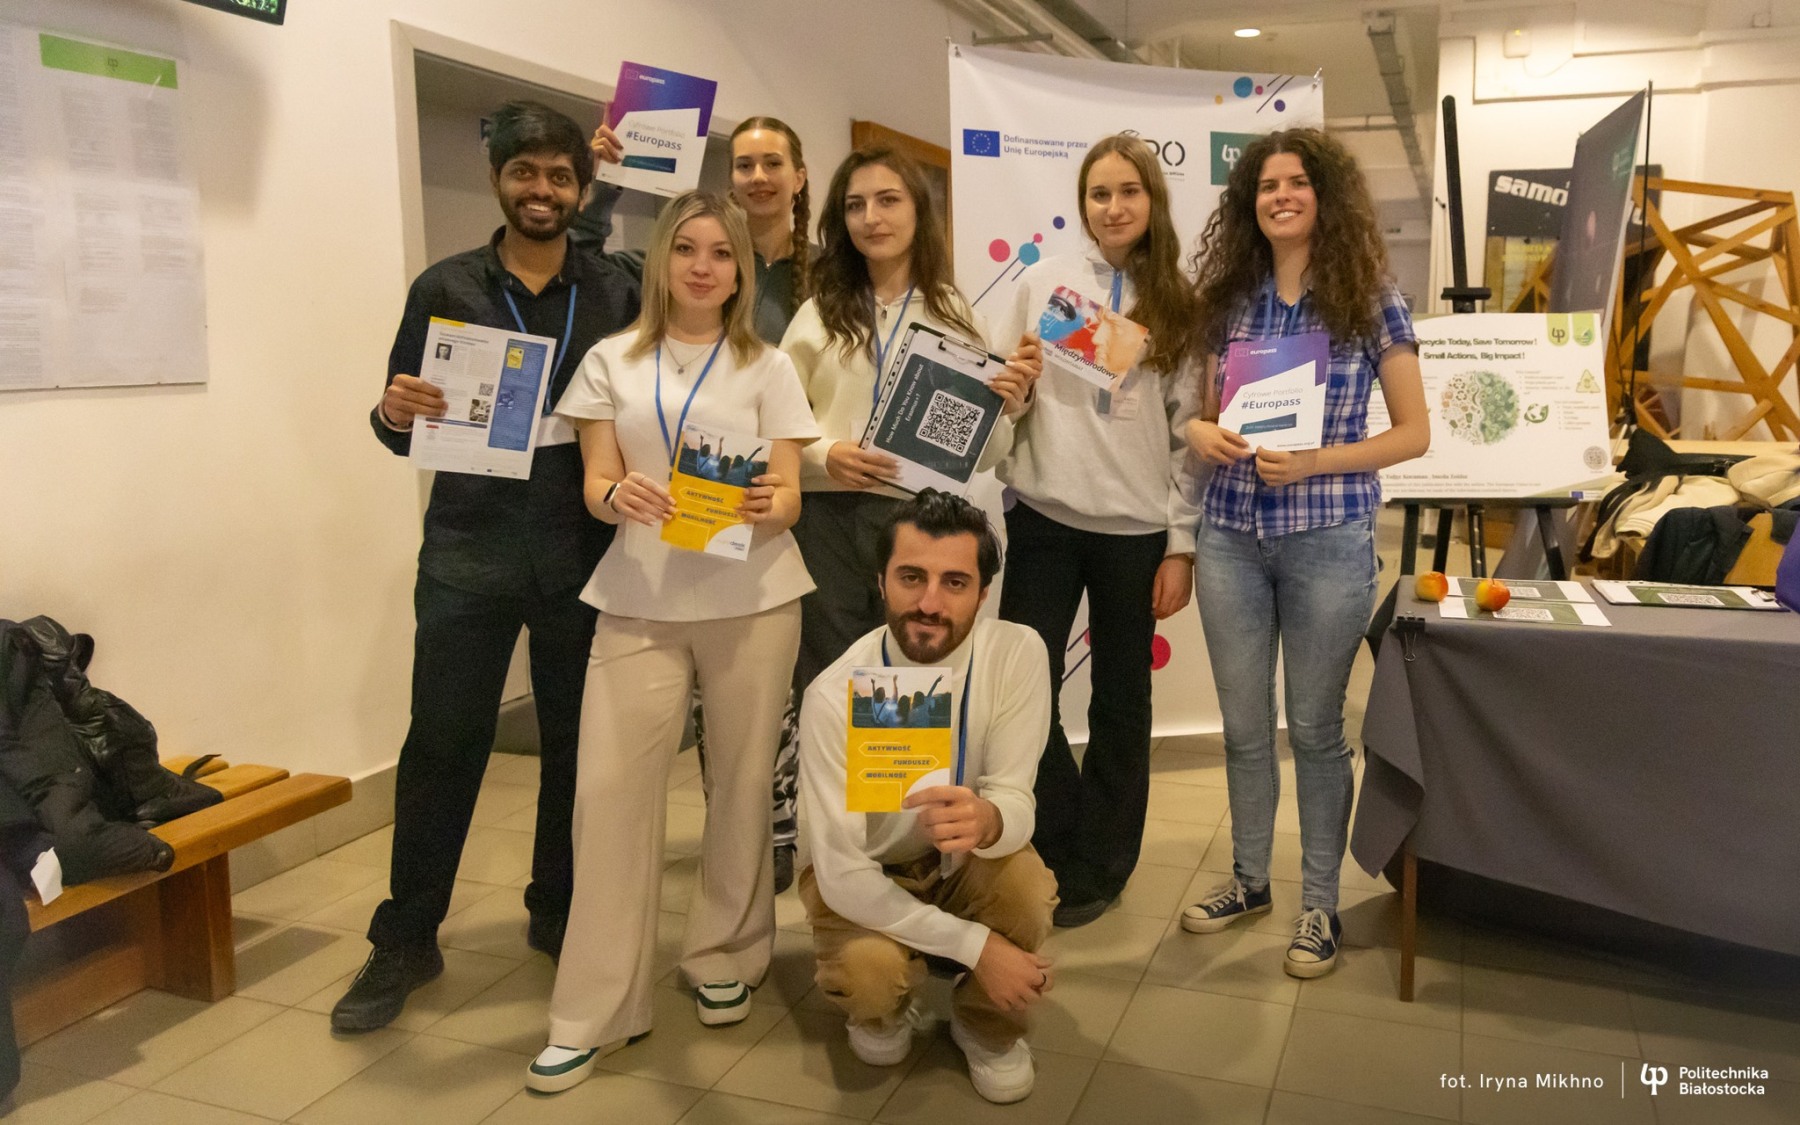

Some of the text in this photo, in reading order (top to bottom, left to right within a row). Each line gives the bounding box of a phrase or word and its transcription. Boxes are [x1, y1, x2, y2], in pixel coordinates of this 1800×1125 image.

[626, 130, 682, 151] #Europass
[1003, 134, 1088, 149] Dofinansowane przez
[1003, 145, 1069, 159] Unię Europejską
[1447, 338, 1473, 347] Today,
[1054, 343, 1118, 380] Międzynarodowy
[1423, 352, 1446, 360] Small
[1447, 352, 1478, 361] Actions,
[1480, 352, 1494, 361] Big
[906, 380, 917, 396] Know
[901, 396, 910, 407] You
[1241, 398, 1302, 410] #Europass
[898, 406, 906, 416] Do
[891, 415, 901, 431] Much
[886, 430, 895, 443] How
